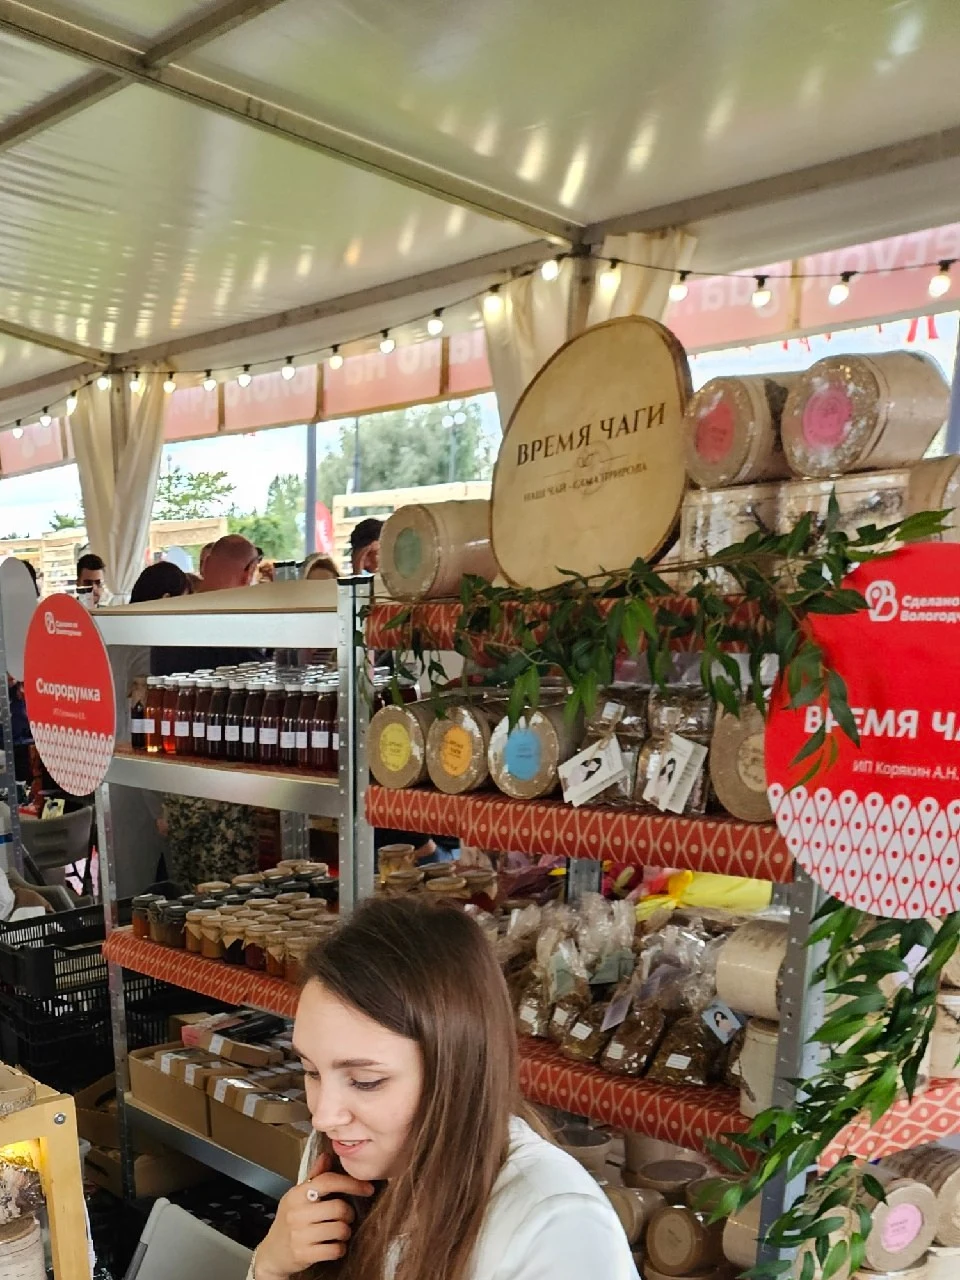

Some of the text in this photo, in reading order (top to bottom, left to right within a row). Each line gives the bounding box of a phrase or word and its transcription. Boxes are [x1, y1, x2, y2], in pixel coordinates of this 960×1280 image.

[517, 402, 666, 466] ВРЕМЯ ЧАГИ
[901, 595, 960, 611] Сделано
[35, 677, 101, 702] Скородумка
[853, 759, 960, 781] ИП Корякин А.Н.
